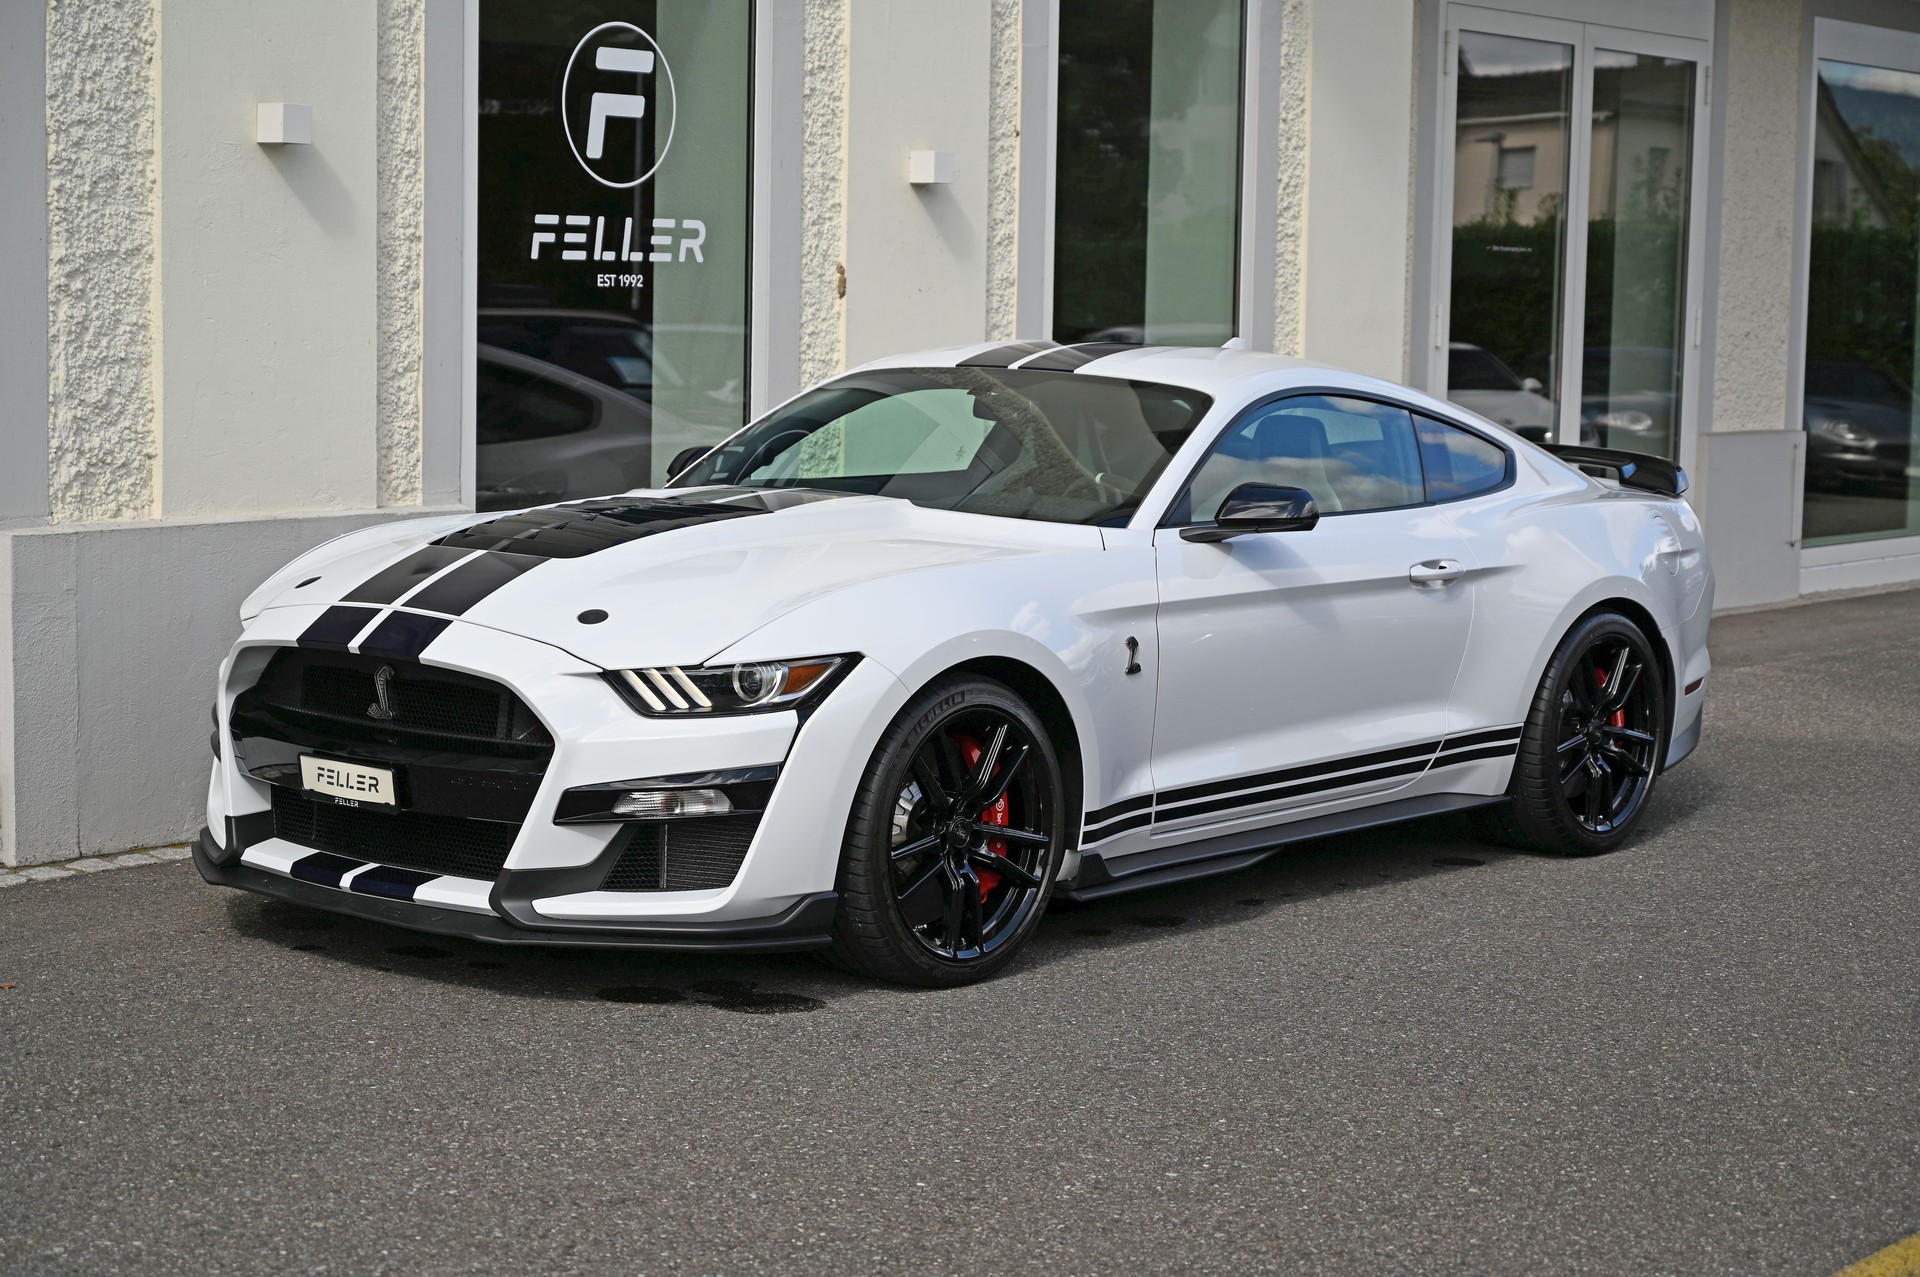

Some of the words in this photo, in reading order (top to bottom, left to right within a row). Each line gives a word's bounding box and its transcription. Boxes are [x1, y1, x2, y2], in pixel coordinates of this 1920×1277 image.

[586, 46, 655, 160] F
[530, 214, 706, 263] FELLER
[597, 273, 617, 287] EST
[618, 274, 644, 288] 1992
[907, 692, 962, 745] MICHELIN
[317, 766, 379, 793] FELLER
[334, 797, 359, 807] FELLER
